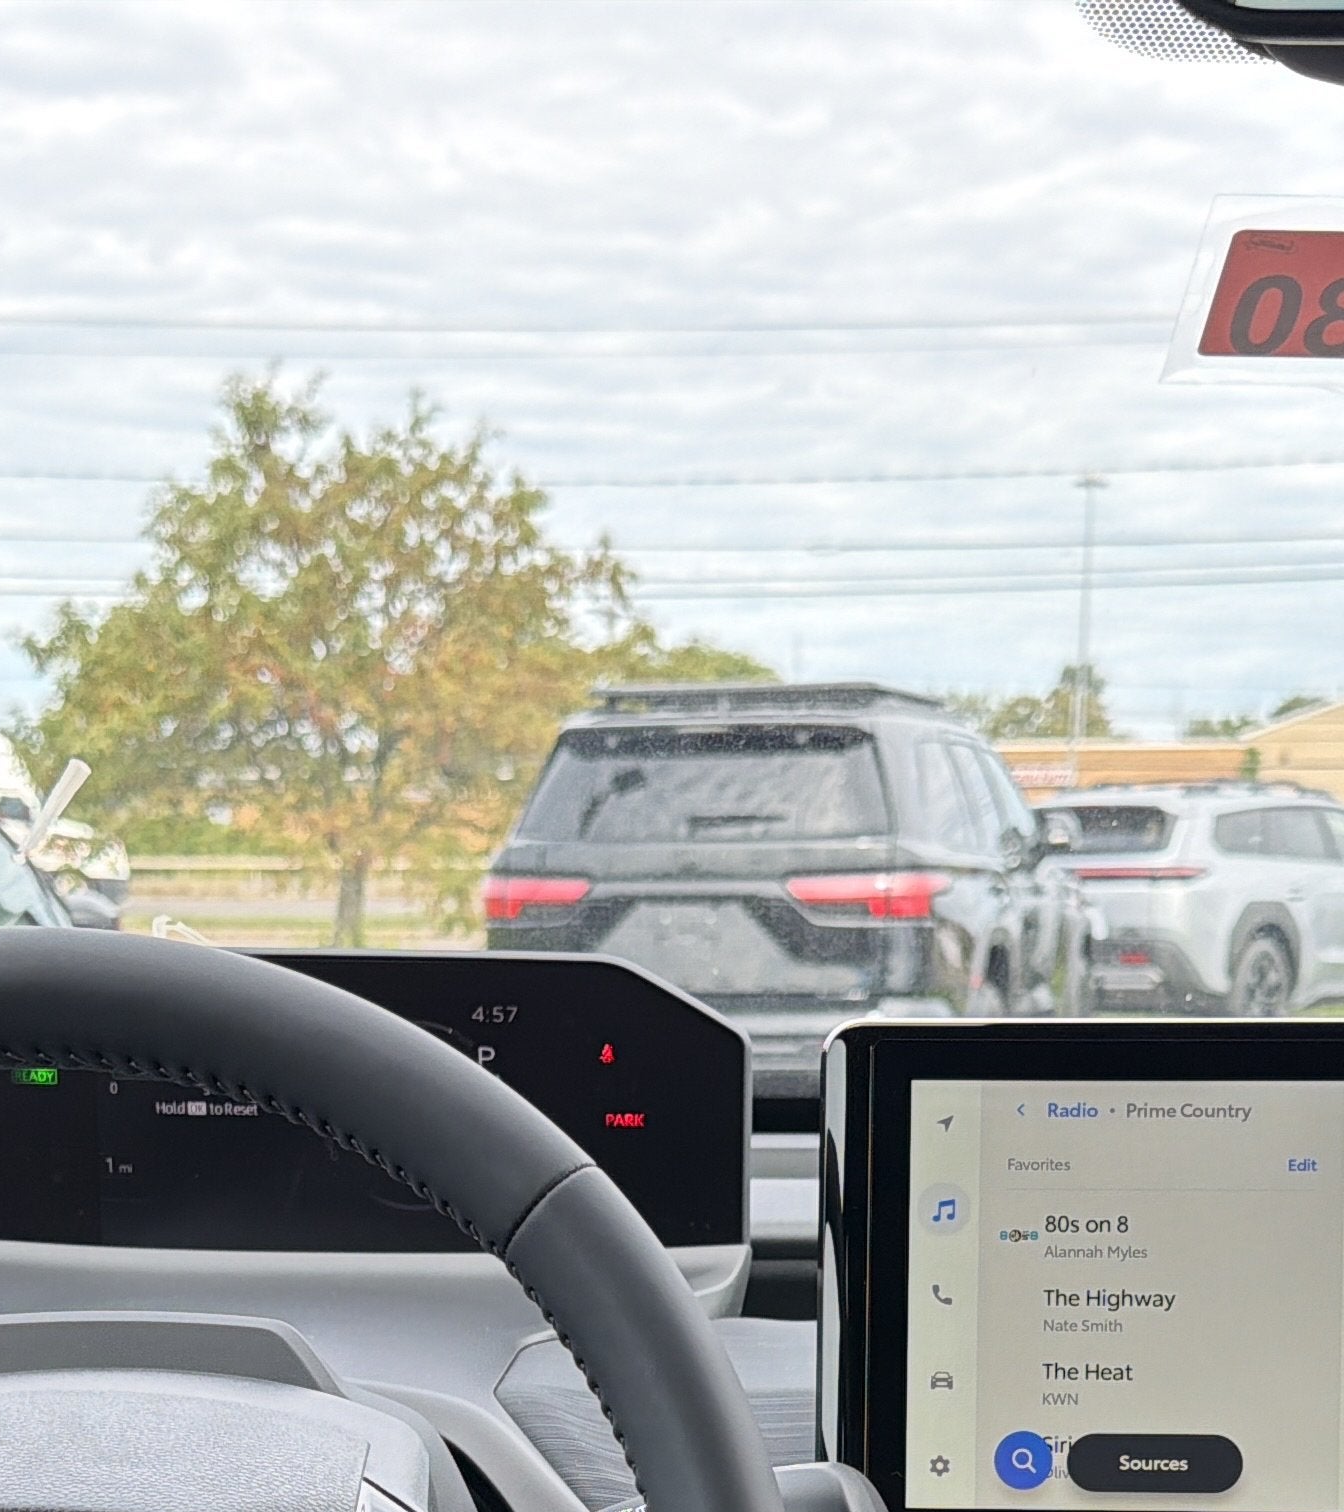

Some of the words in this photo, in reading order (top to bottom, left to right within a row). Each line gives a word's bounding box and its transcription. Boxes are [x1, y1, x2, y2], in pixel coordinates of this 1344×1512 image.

[472, 1006, 518, 1023] 4:57
[477, 1046, 496, 1065] P
[14, 1071, 54, 1084] READY
[109, 1082, 119, 1094] 0
[155, 1101, 185, 1115] Hold
[188, 1101, 207, 1116] OK
[209, 1102, 223, 1115] to
[225, 1102, 258, 1116] Reset
[1047, 1102, 1099, 1118] Radio
[1126, 1102, 1177, 1118] Prime
[1180, 1102, 1252, 1122] Country
[605, 1113, 645, 1127] PARK
[105, 1157, 114, 1174] 1
[119, 1161, 133, 1173] mi
[1007, 1157, 1071, 1172] Favorites
[1287, 1158, 1318, 1172] Edit
[1044, 1215, 1080, 1234] 80s
[1085, 1220, 1112, 1234] on
[1116, 1216, 1129, 1234] 8
[1044, 1244, 1103, 1259] Alannah
[1106, 1244, 1148, 1262] Myles
[1043, 1289, 1081, 1307] The
[1085, 1289, 1176, 1311] Highway
[1043, 1319, 1077, 1332] Nate
[1081, 1319, 1123, 1332] Smith
[1042, 1363, 1079, 1380] The
[1085, 1363, 1133, 1380] Heat
[1042, 1393, 1079, 1406] KWN
[1119, 1455, 1189, 1471] Sources
